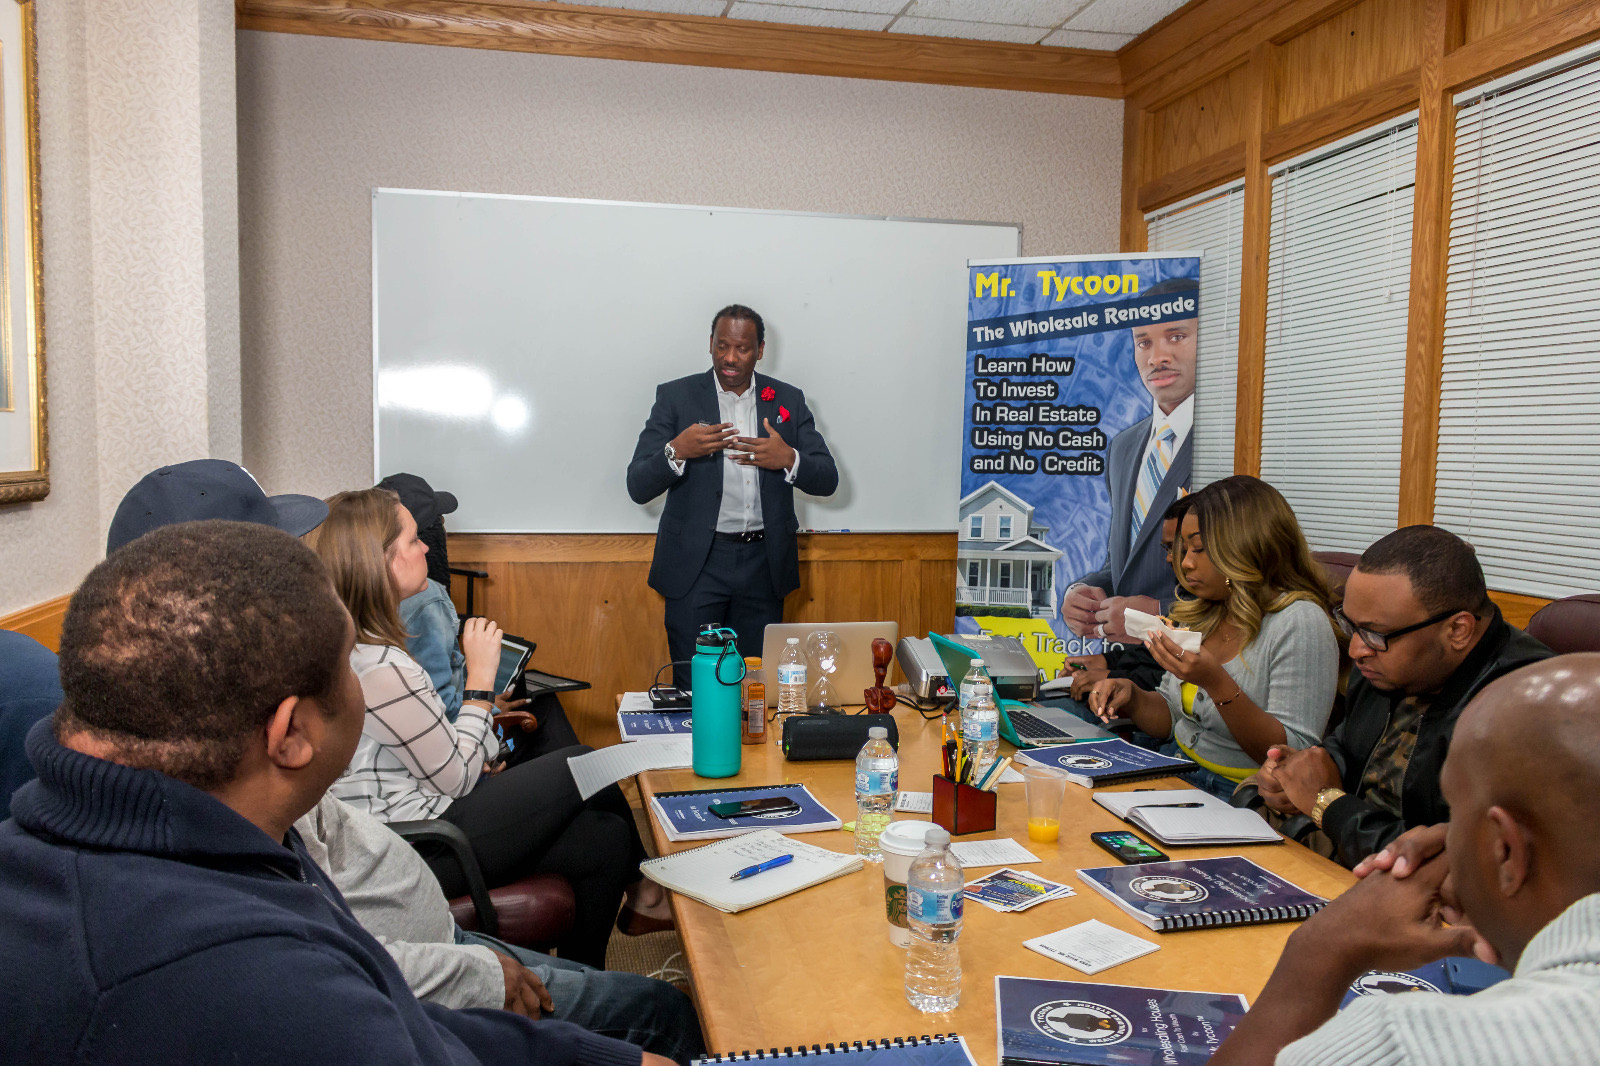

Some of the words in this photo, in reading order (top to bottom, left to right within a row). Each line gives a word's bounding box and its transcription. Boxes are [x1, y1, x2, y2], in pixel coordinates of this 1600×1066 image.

[975, 273, 1016, 298] Mr.
[1037, 270, 1139, 302] Tycoon
[973, 326, 1005, 343] The
[1009, 312, 1099, 338] Wholesale
[1104, 296, 1196, 325] Renegade
[977, 357, 1027, 373] Learn
[1032, 357, 1072, 373] How
[976, 381, 998, 397] To
[1002, 381, 1055, 397] Invest
[975, 406, 991, 422] In
[996, 406, 1034, 422] Real
[1038, 406, 1097, 422] Estate
[975, 431, 1023, 450] Using
[1028, 431, 1054, 447] No
[1058, 431, 1104, 447] Cash
[973, 456, 1004, 471] and
[1009, 456, 1035, 471] No
[1044, 456, 1102, 472] Credit
[1032, 632, 1094, 655] Track
[1147, 998, 1163, 1022] Houses
